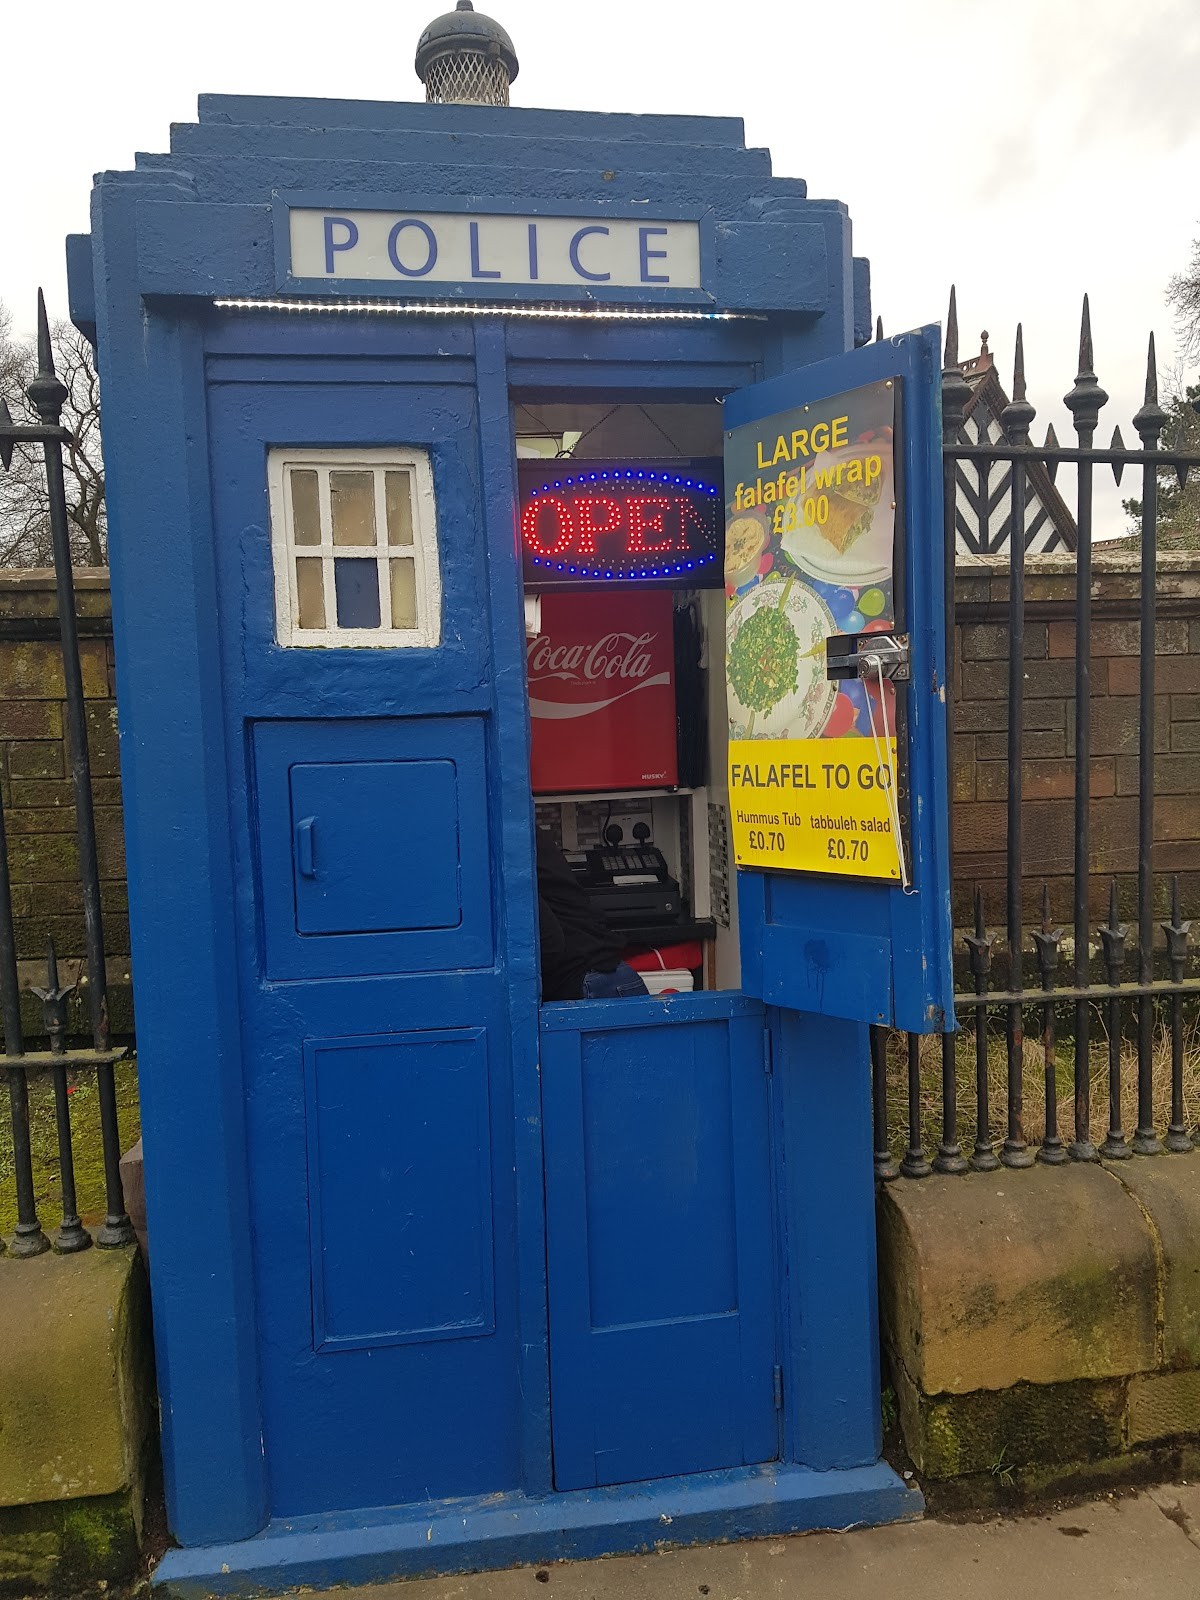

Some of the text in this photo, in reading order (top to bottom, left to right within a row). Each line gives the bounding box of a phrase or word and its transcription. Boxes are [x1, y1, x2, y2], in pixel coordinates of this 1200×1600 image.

[323, 216, 670, 283] POLICE
[757, 415, 849, 469] LARGE
[735, 454, 882, 510] falafel wrap
[521, 496, 718, 555] OPEN
[773, 494, 830, 534] £3.00
[731, 763, 892, 790] FALAFEL TO GO
[736, 810, 801, 826] Hummus Tub
[810, 815, 891, 832] tabbuleh salad
[749, 830, 785, 852] £0.70
[827, 838, 869, 862] £0.70
